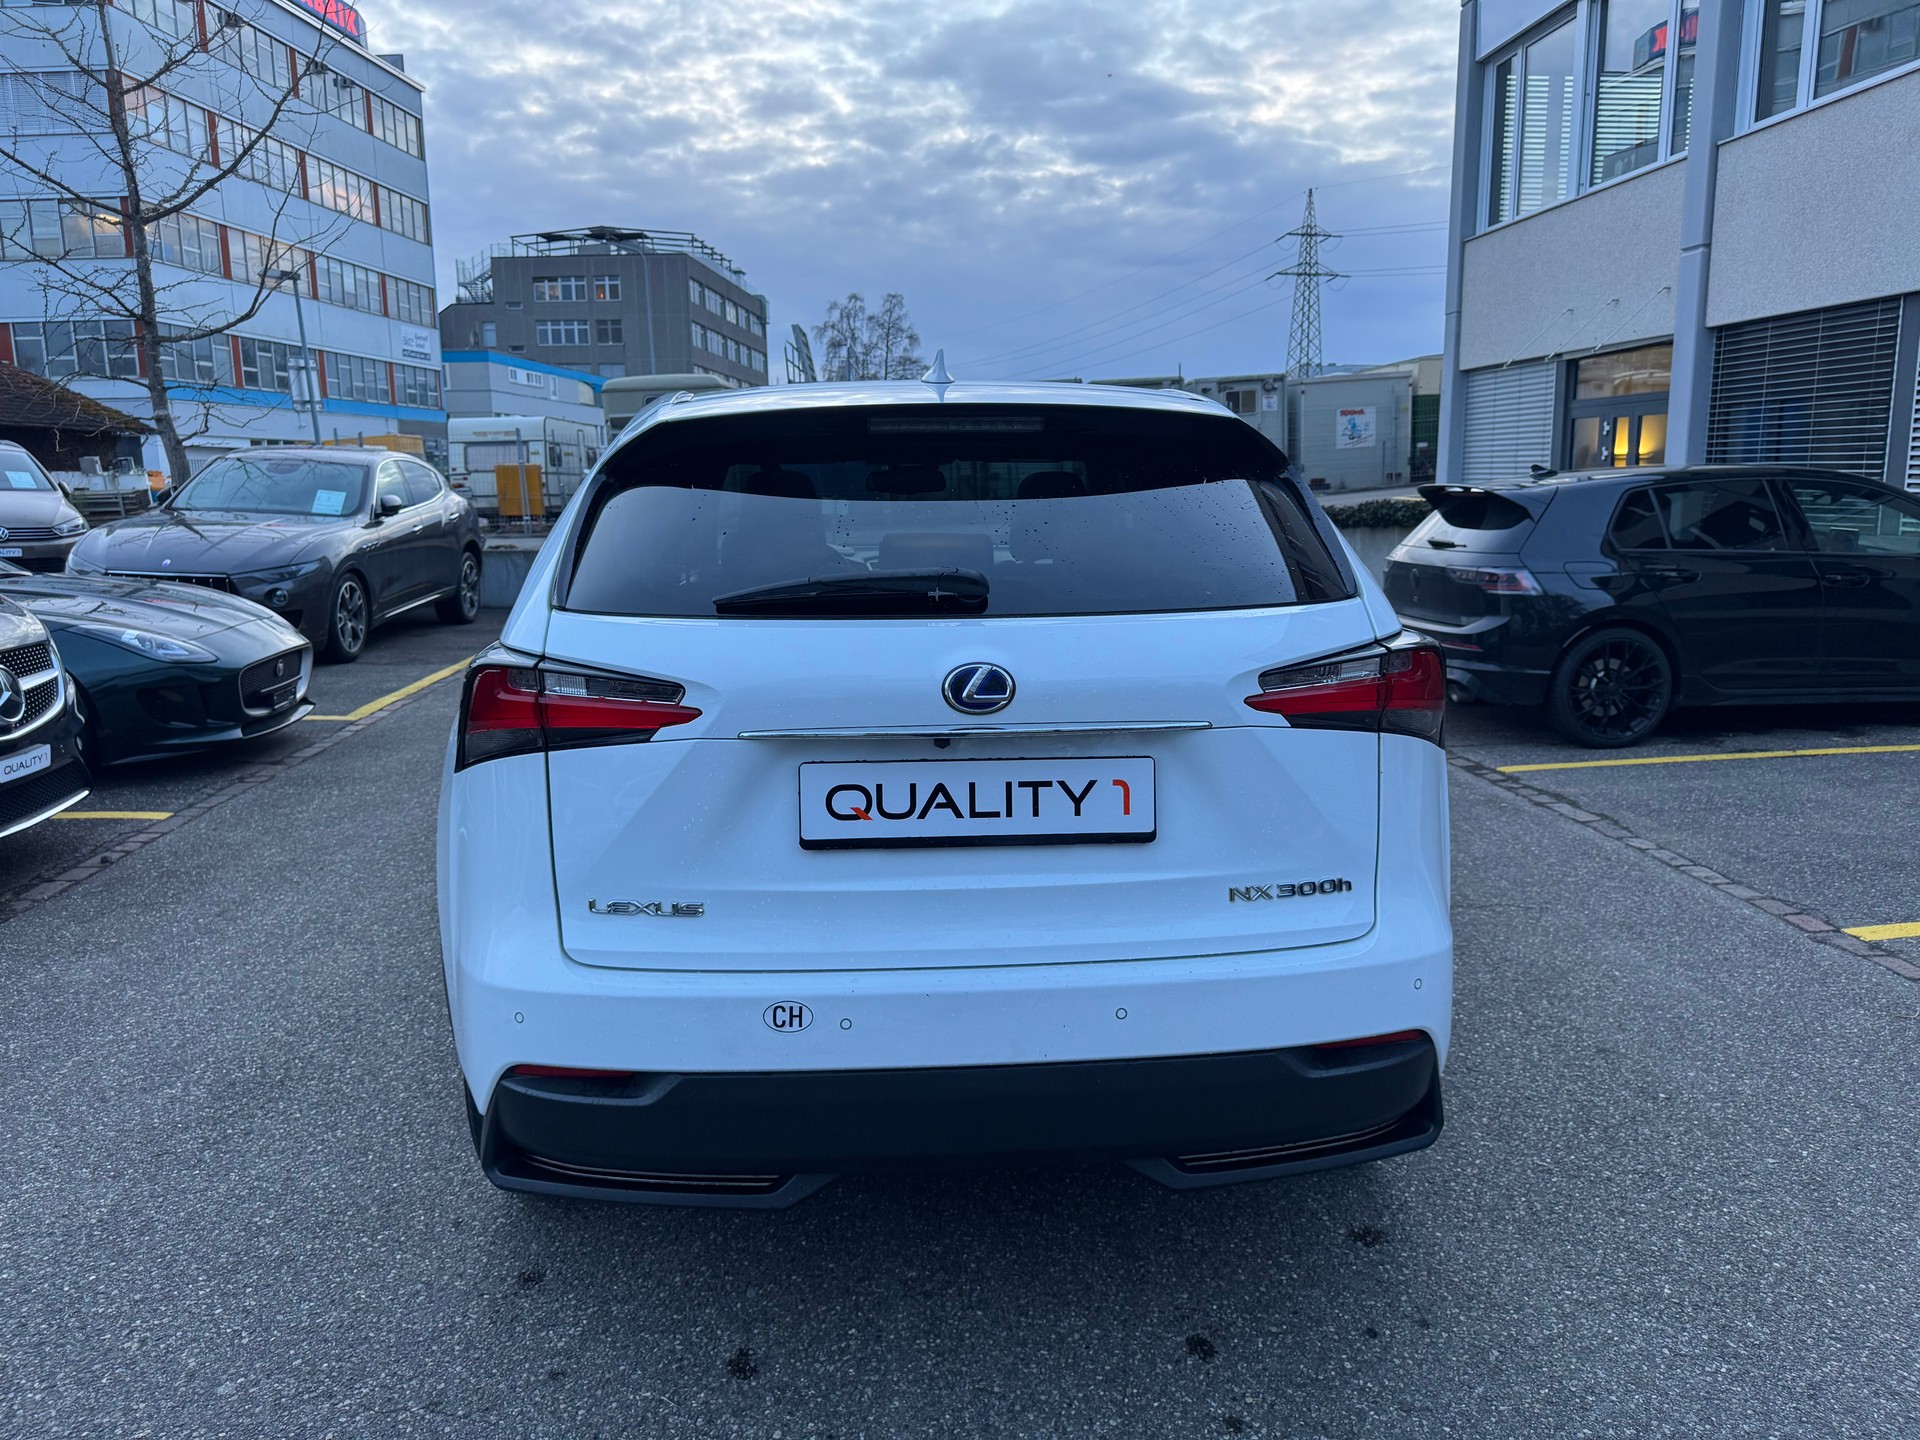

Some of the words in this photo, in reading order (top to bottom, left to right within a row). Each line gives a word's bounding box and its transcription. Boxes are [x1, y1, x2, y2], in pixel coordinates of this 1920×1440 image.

[3, 753, 44, 775] QUALITY
[825, 779, 1098, 821] QUALITY
[1112, 779, 1131, 816] 1
[588, 898, 705, 917] LEXUS
[772, 1005, 803, 1028] CH
